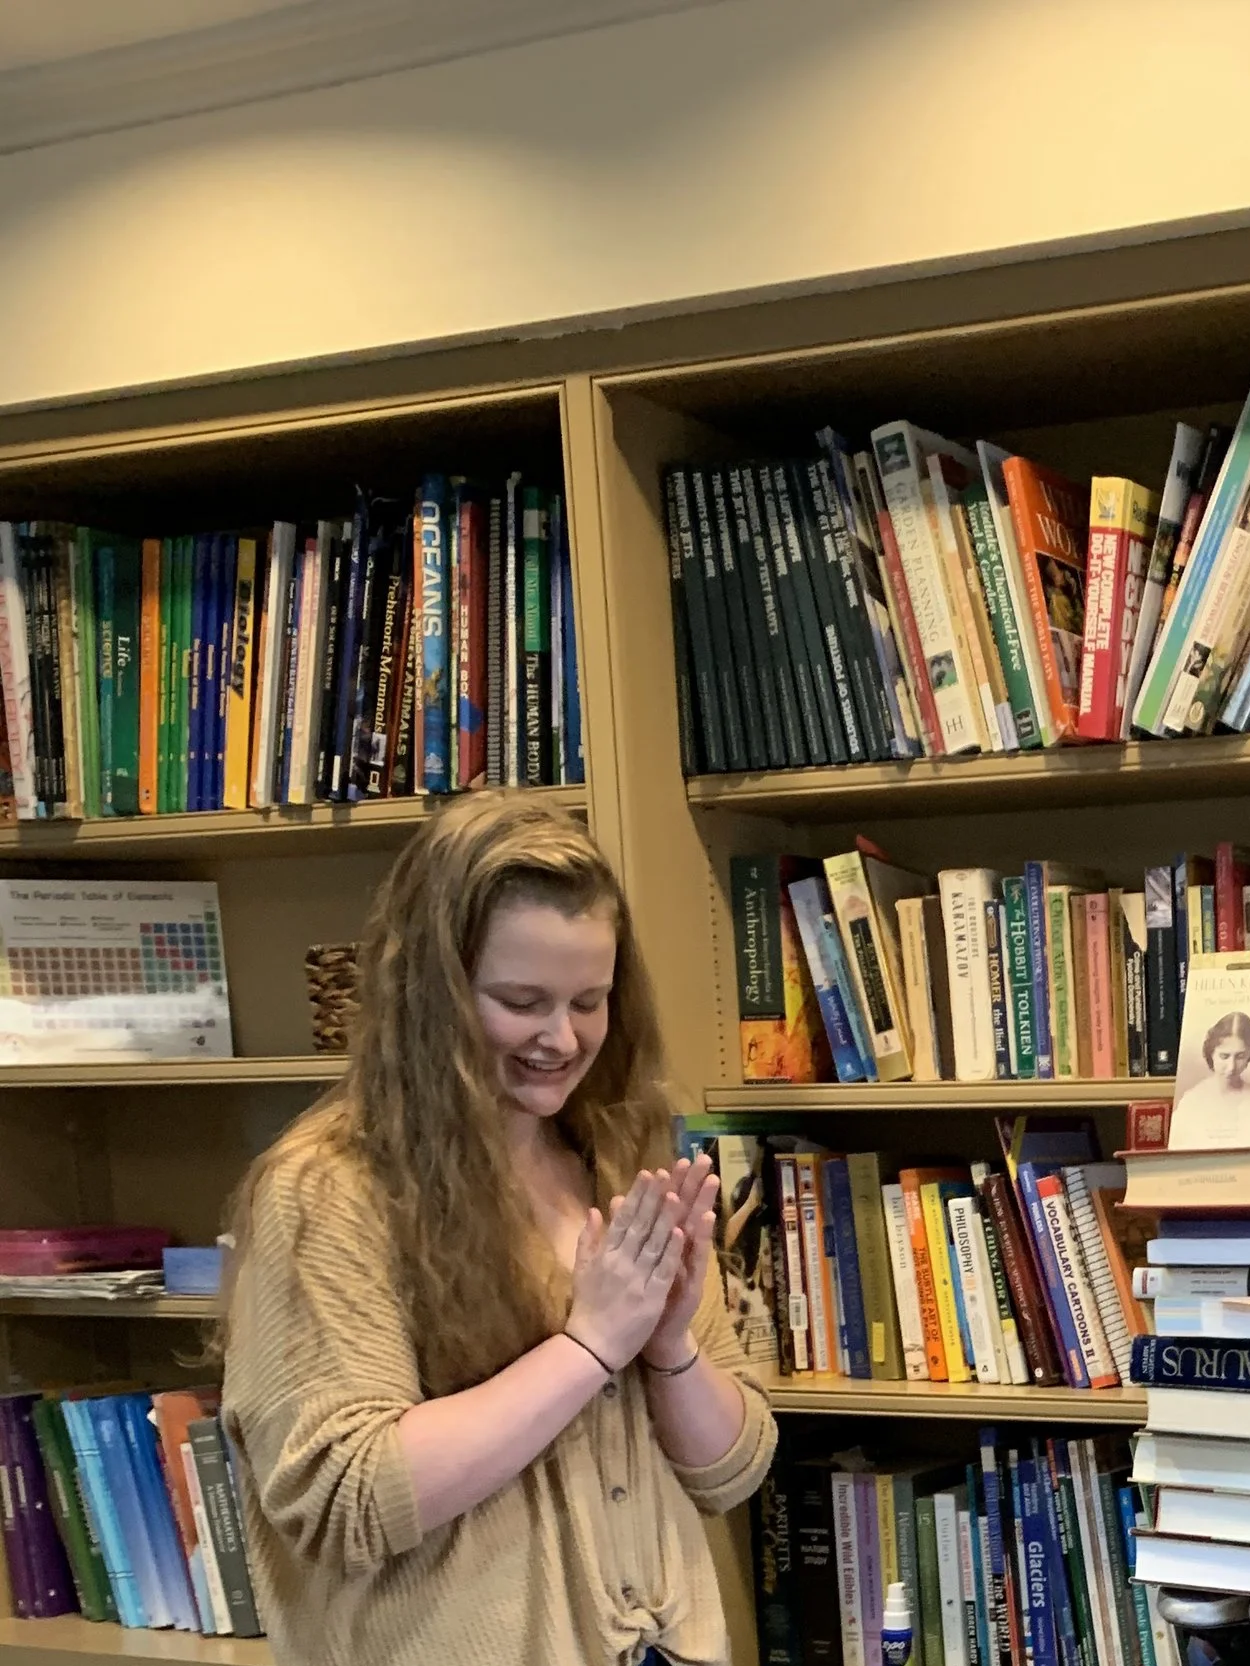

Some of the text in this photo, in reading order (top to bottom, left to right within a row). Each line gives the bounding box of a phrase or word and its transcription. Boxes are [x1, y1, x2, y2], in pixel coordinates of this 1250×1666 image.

[671, 470, 694, 559] FIGHTING JETS
[421, 500, 441, 636] OCEANS
[757, 562, 771, 593] TEST
[893, 481, 920, 552] GARDEN
[911, 555, 940, 644] PLANNING
[966, 502, 1000, 616] Yard & Garden
[977, 499, 1000, 562] Rodale's
[990, 562, 1025, 672] Chemical-Free
[1021, 552, 1034, 584] WHAT
[1028, 586, 1040, 608] THE
[1095, 533, 1117, 650] NEW COMPLETE
[116, 635, 128, 666] Life
[228, 579, 254, 699] Biology
[372, 574, 402, 733] Prehistoric Mammals
[763, 594, 779, 636] PILOTS
[823, 625, 847, 681] FORTUNE
[1033, 611, 1048, 652] WORLD
[1079, 532, 1104, 715] DO-IT-YOURSELF MANUAL
[412, 607, 424, 712] PREDATORS
[395, 671, 413, 757] ANIMALS
[525, 654, 537, 779] The HUMAN BODY
[838, 698, 862, 755] SOLDIERS
[10, 891, 29, 901] The
[34, 891, 76, 901] Periodic
[112, 891, 123, 901] of
[127, 891, 174, 901] Elements
[951, 892, 968, 979] KARAMAZOV
[743, 887, 766, 1005] Anthropology
[1010, 920, 1027, 979] HOBBIT
[1195, 977, 1236, 991] HELEN
[988, 952, 1005, 1052] HOMER the Iliad
[1017, 990, 1032, 1055] TOLKIEN
[1133, 951, 1143, 1032] Crime and Punishment
[891, 1196, 908, 1270] bill bryson
[919, 1247, 939, 1342] THE SUBTLE ART OF
[1045, 1201, 1095, 1358] VOCABULARY CARTOONS II
[208, 1481, 243, 1554] MATHEMATICS
[838, 1484, 857, 1605] Incredible Wild Edibles
[1026, 1541, 1047, 1608] Glaciers
[966, 1604, 979, 1665] DARREN HARDY
[993, 1578, 1011, 1653] The WORLD
[1134, 1604, 1148, 1629] Body
